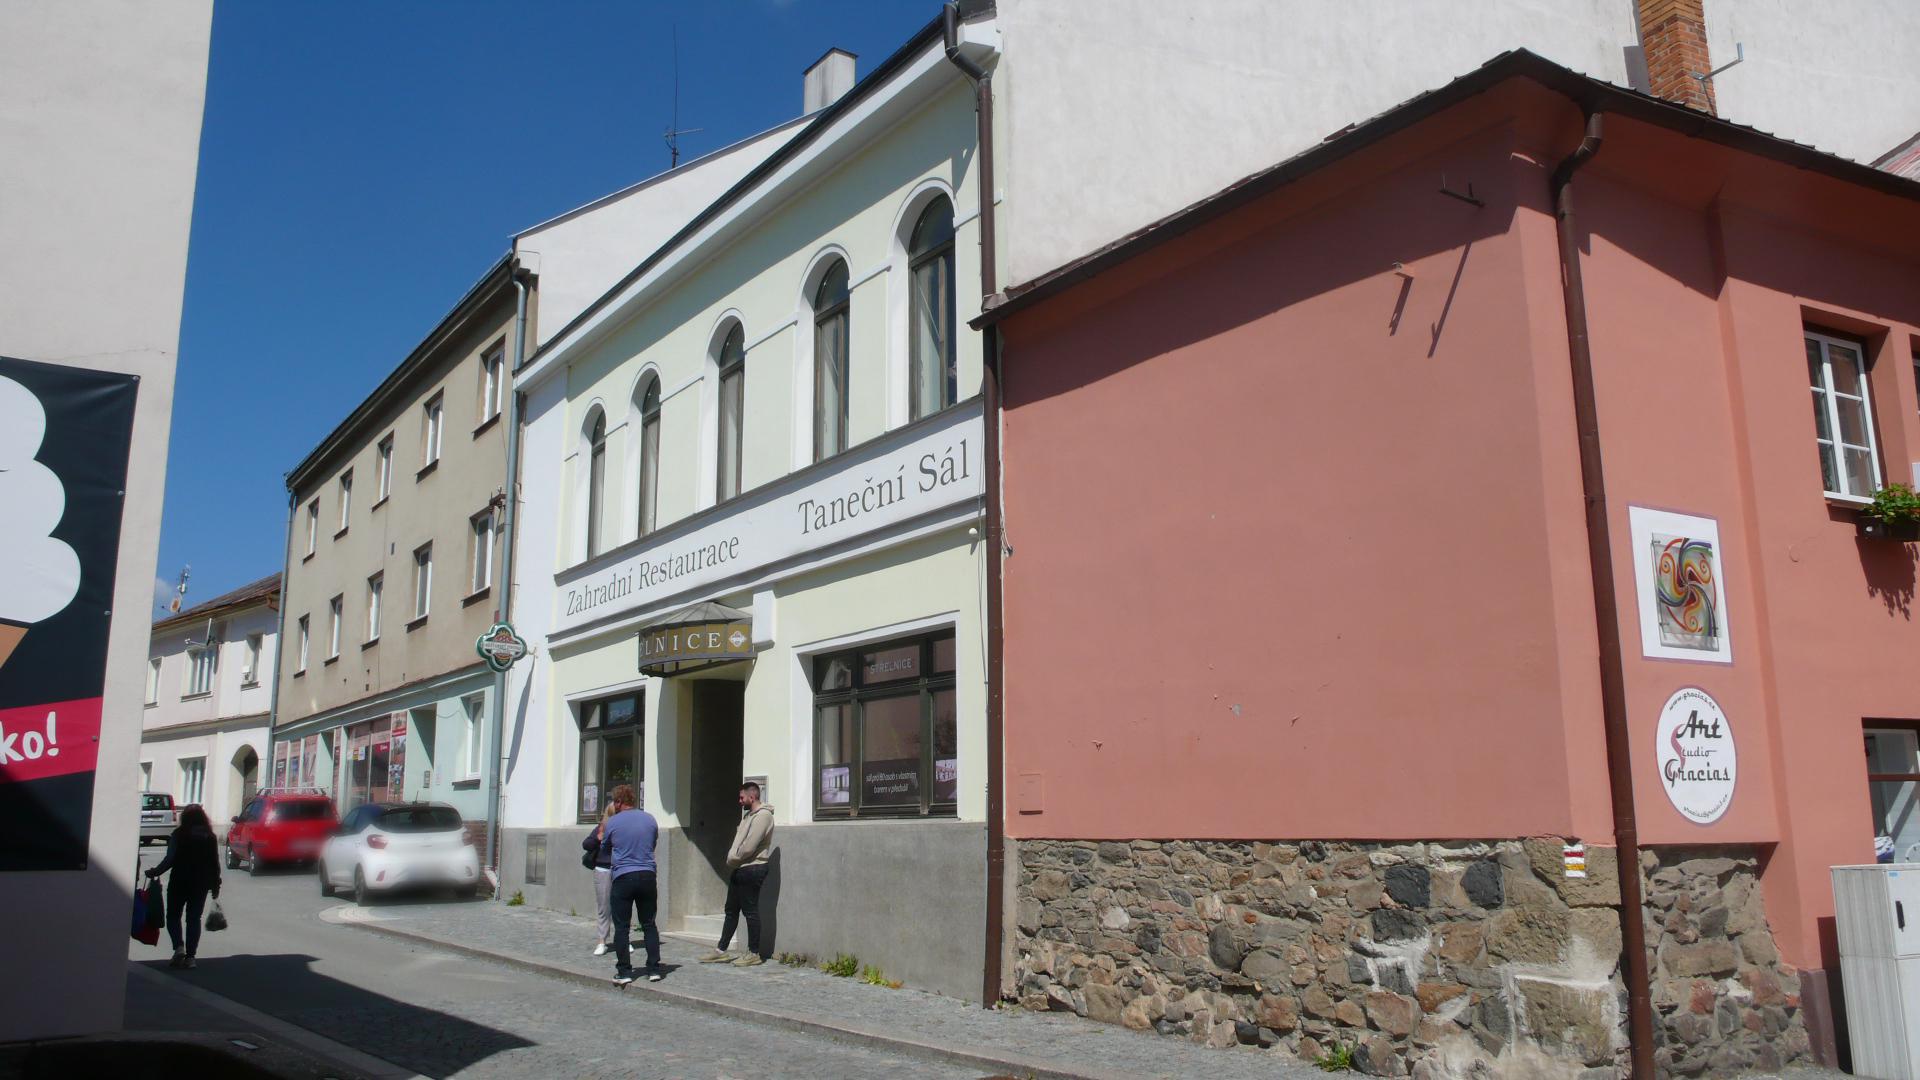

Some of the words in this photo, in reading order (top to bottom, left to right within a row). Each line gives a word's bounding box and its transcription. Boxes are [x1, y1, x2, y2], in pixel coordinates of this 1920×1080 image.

[566, 568, 633, 617] Zahradní
[638, 536, 739, 590] Restaurace
[798, 464, 905, 535] Taneční
[918, 438, 970, 493] Sál
[1676, 710, 1723, 739] Art
[1664, 758, 1731, 788] Gracias
